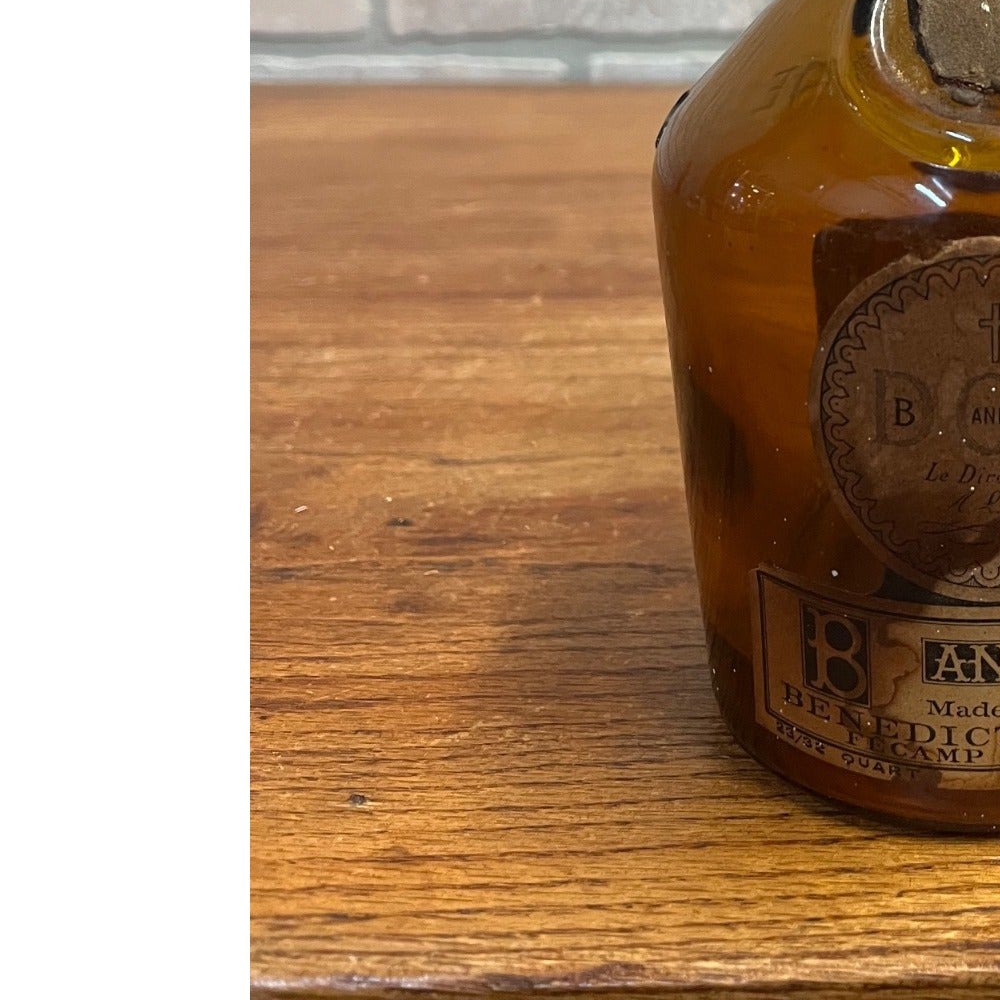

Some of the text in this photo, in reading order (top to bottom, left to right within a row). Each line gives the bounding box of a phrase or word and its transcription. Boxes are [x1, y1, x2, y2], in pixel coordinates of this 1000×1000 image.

[893, 397, 916, 427] B
[925, 461, 949, 483] Le
[807, 607, 868, 700] B
